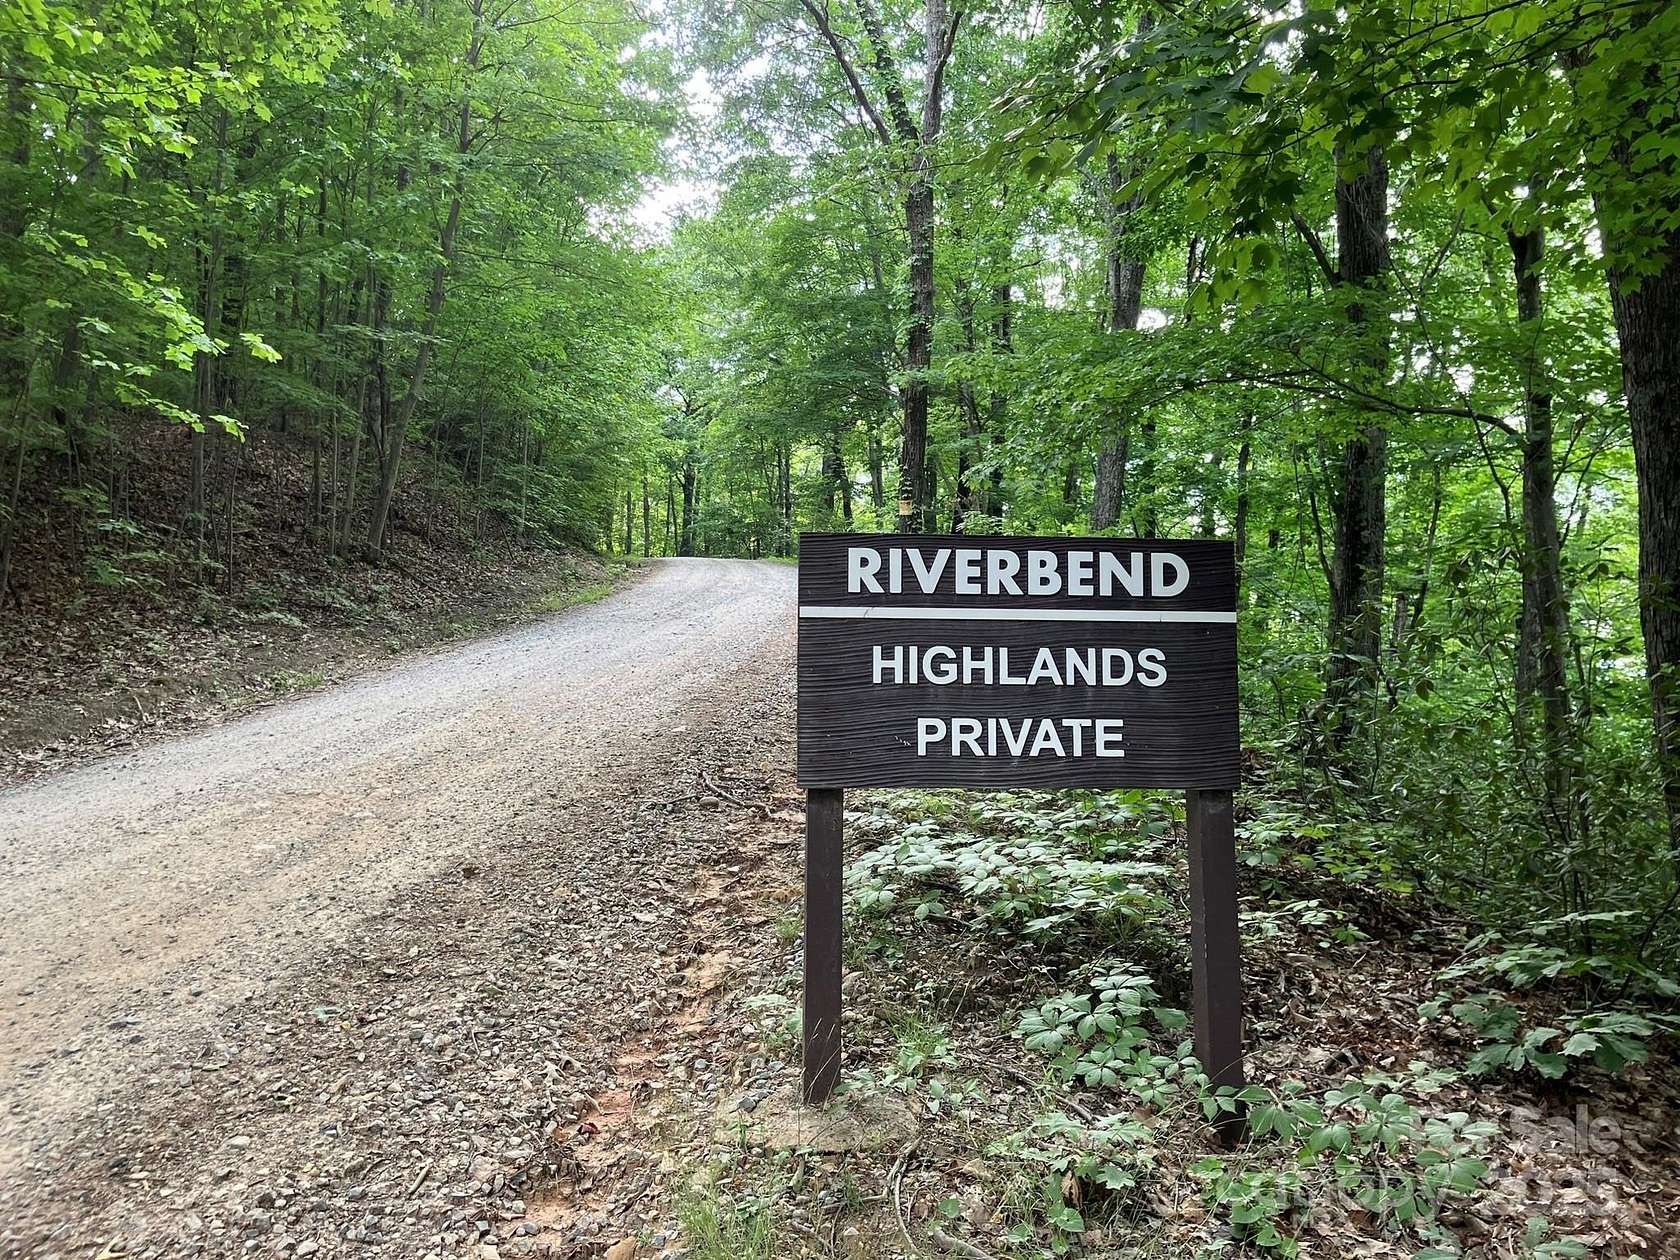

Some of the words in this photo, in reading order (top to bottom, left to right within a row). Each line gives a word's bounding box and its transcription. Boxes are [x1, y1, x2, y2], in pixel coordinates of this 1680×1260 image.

[847, 547, 1190, 597] RIVERBEND
[872, 645, 1168, 687] HIGHLANDS
[917, 717, 1125, 757] PRIVATE
